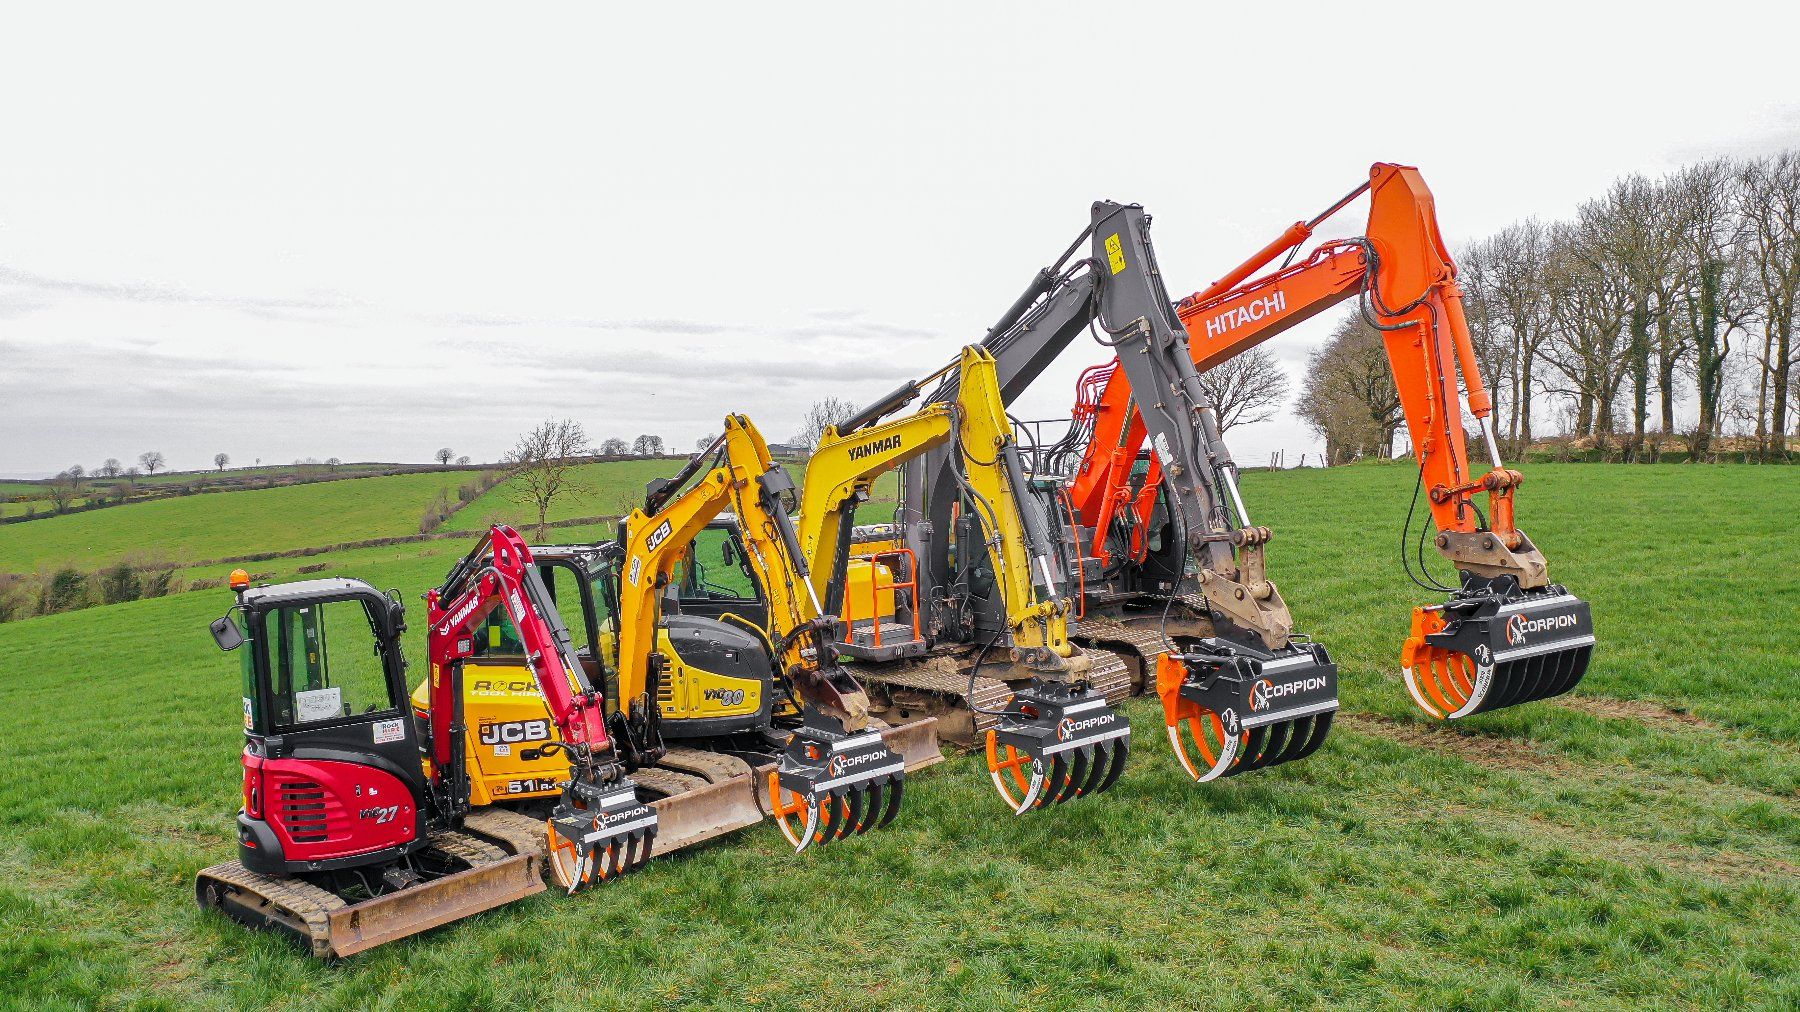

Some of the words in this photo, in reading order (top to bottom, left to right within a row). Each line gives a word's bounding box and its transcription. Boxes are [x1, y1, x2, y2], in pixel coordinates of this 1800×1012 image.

[1206, 290, 1286, 339] HITACHI
[848, 434, 902, 462] YANMAR
[649, 520, 671, 551] JCB
[450, 595, 479, 627] YANMAR
[482, 720, 549, 744] JCB
